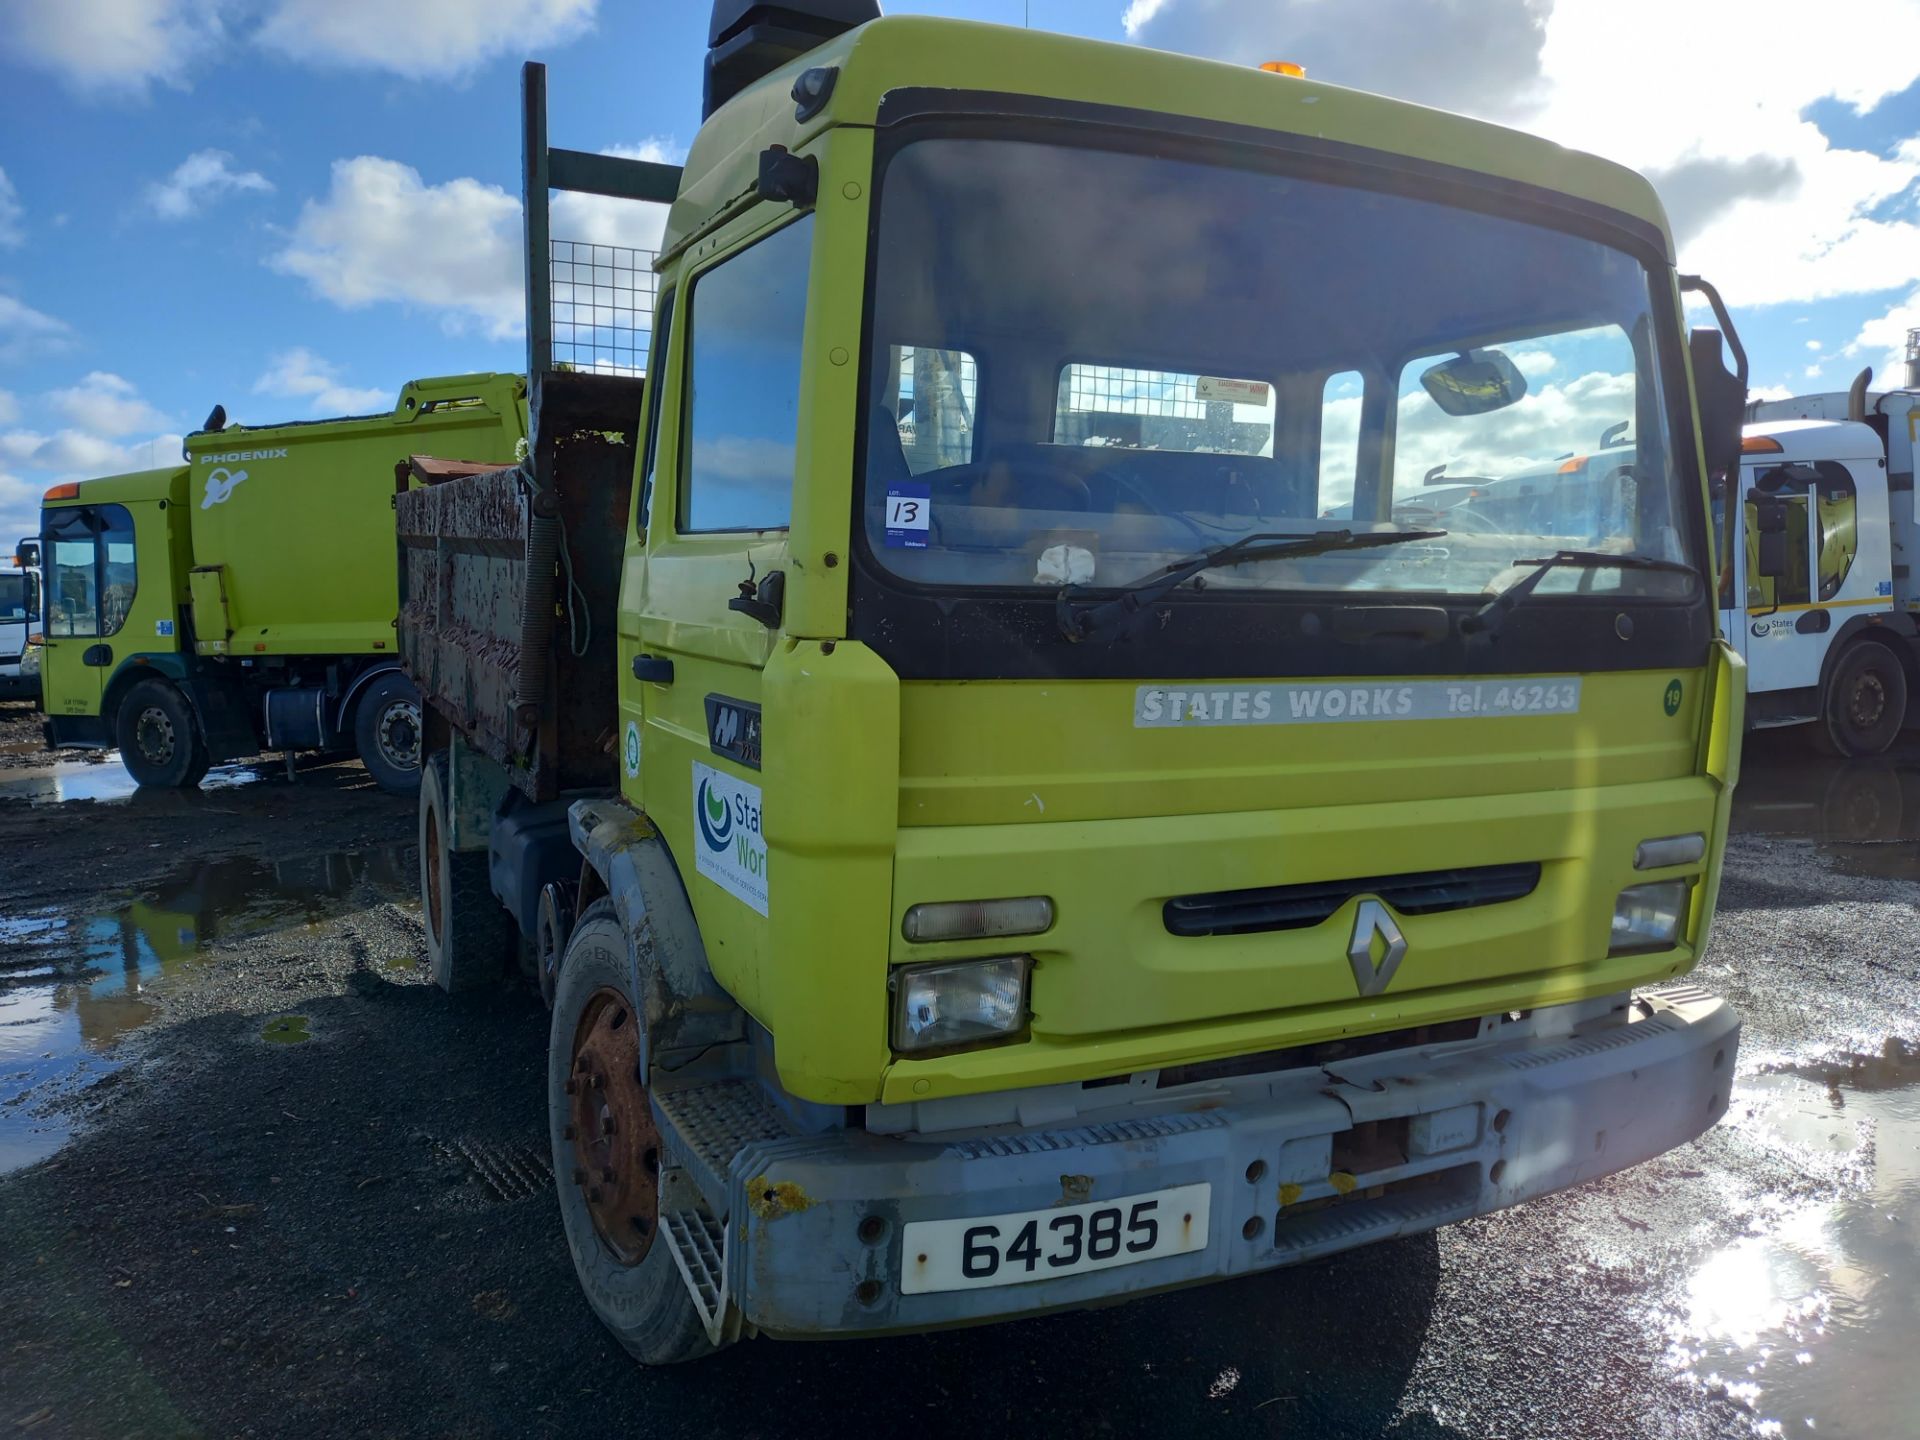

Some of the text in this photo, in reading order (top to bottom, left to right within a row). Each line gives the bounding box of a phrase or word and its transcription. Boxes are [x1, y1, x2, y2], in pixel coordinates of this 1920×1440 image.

[201, 448, 288, 464] PHOENIX
[894, 502, 919, 522] 13
[1772, 620, 1793, 628] States
[1142, 684, 1576, 721] STATES WORKS Tel. 46263
[1666, 689, 1680, 706] 19
[962, 1200, 1158, 1278] 64385
